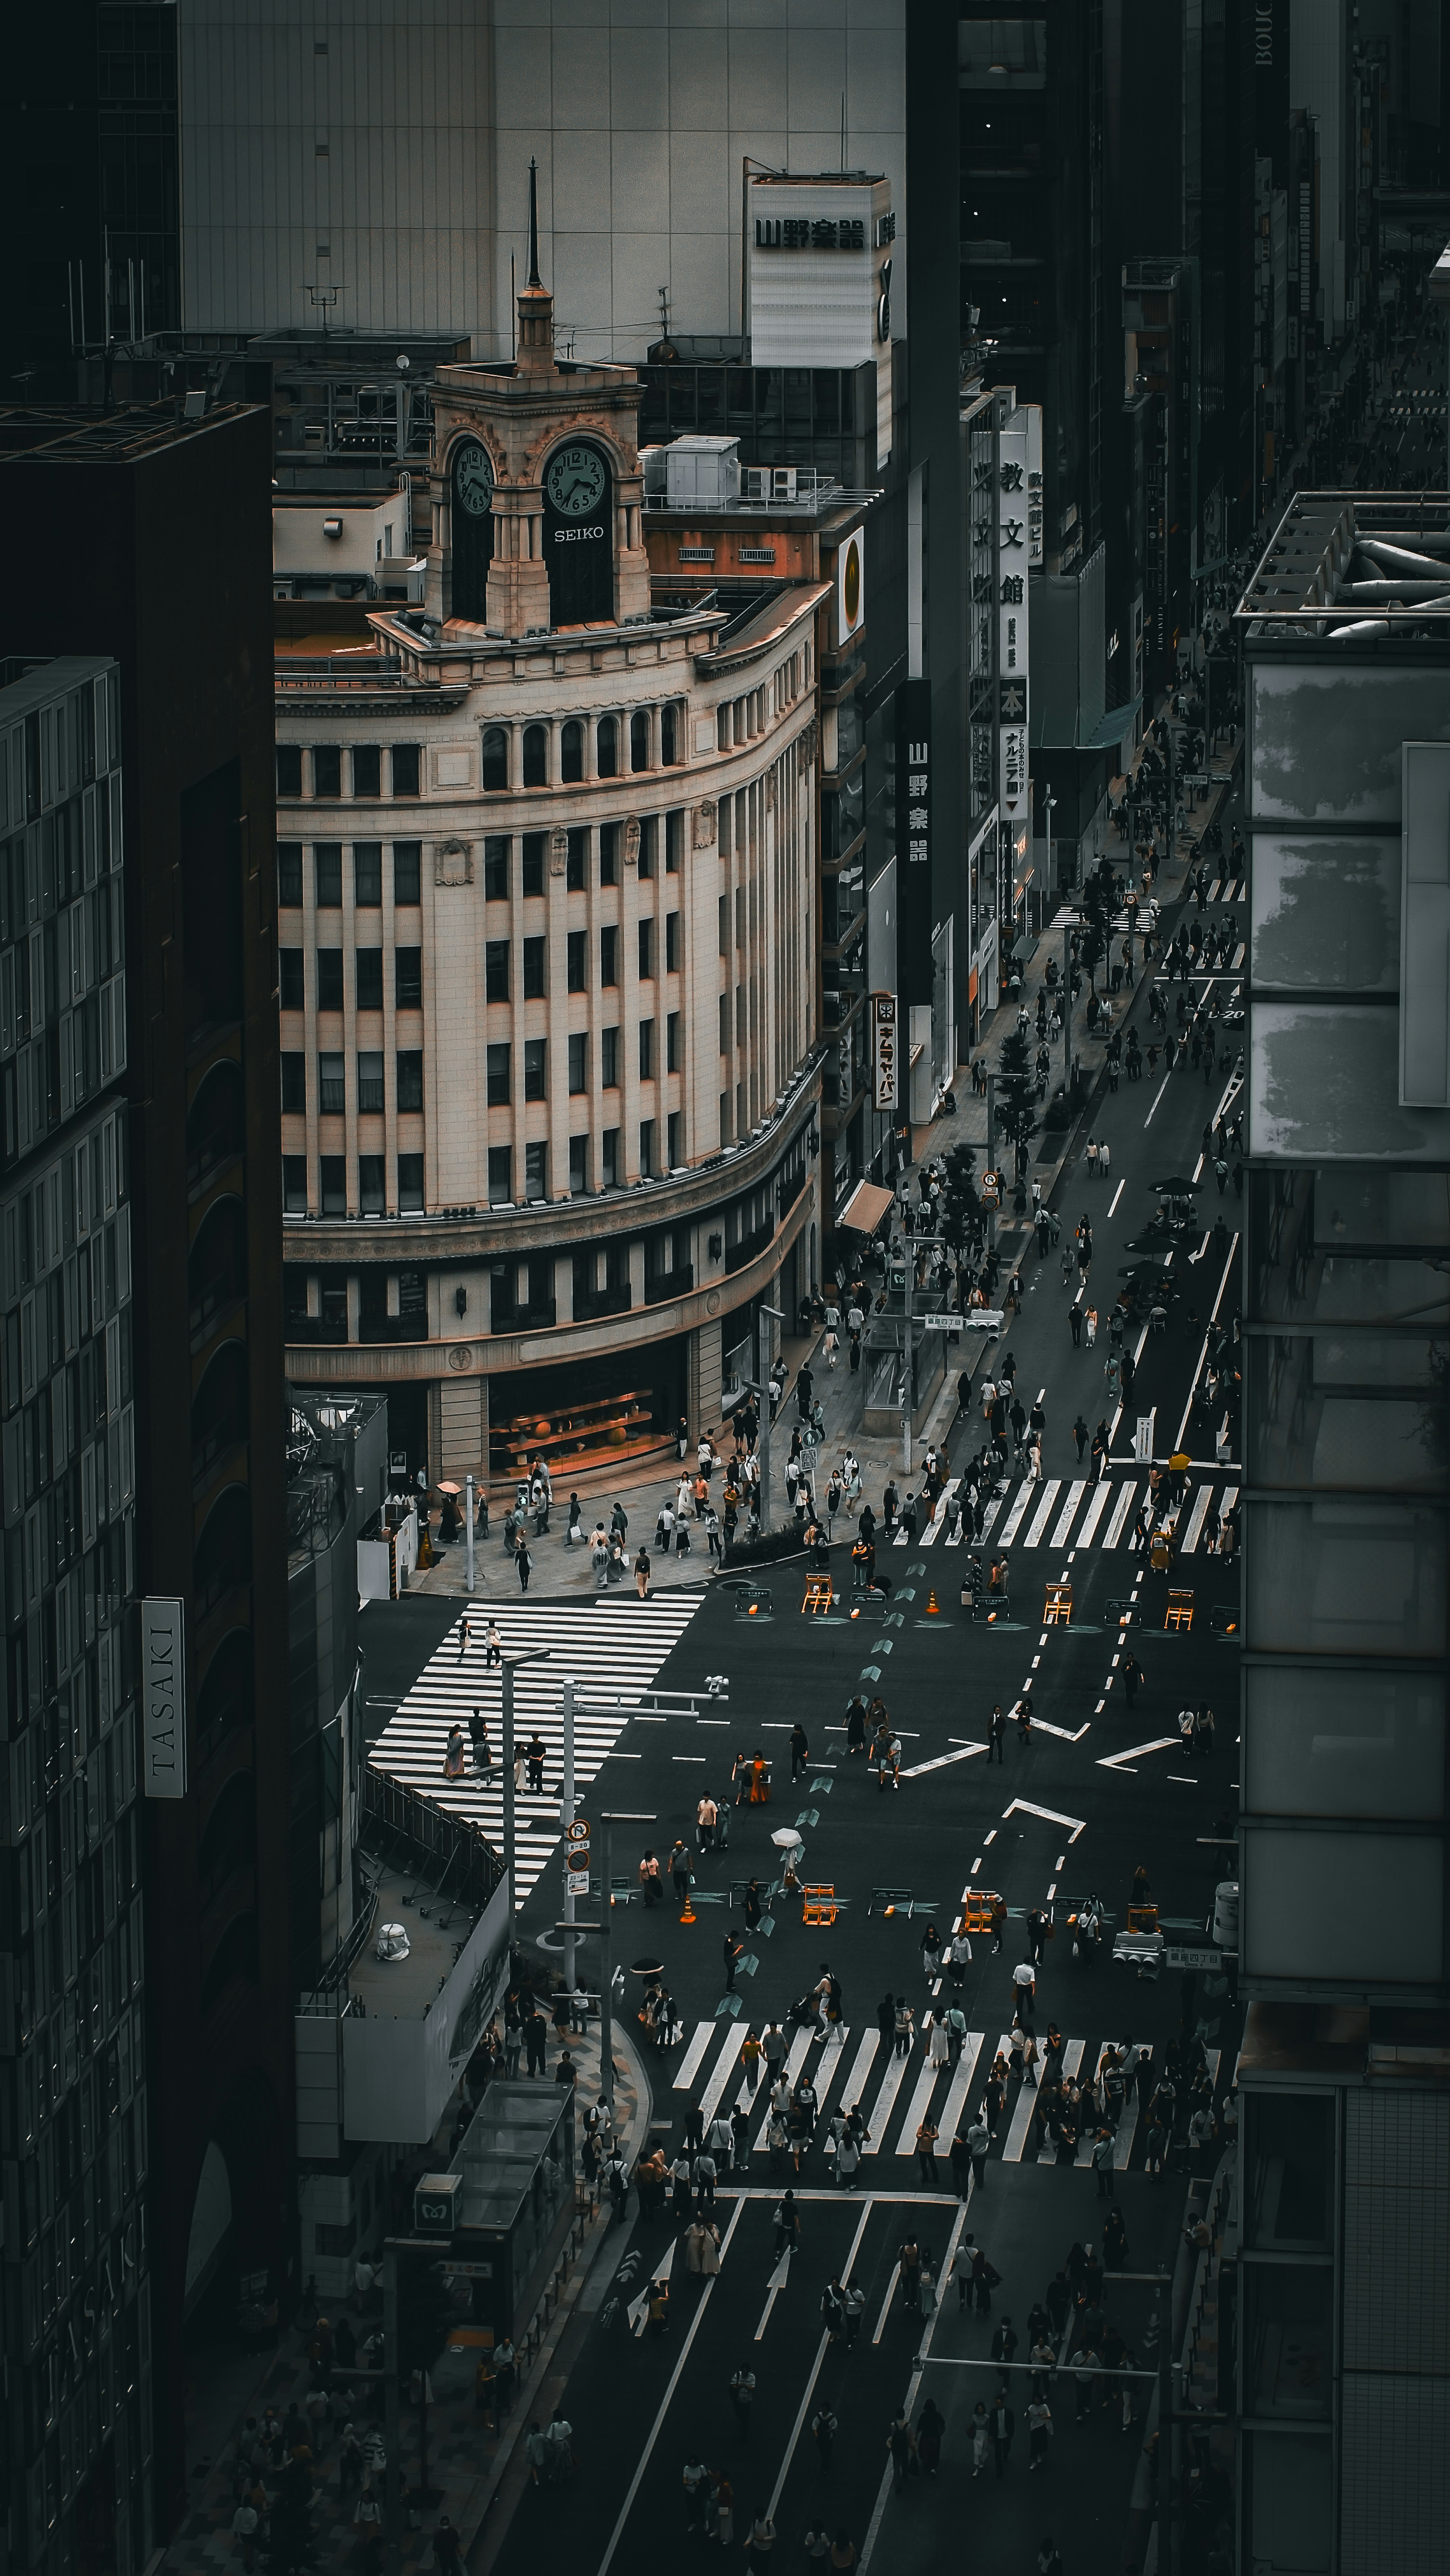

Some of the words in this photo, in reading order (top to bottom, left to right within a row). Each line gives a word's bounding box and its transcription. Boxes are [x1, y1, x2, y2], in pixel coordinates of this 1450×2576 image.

[756, 218, 864, 249] 山野楽器
[467, 453, 471, 464] 11
[472, 451, 478, 462] 12
[480, 455, 482, 466] 1
[563, 454, 569, 467] 11
[572, 452, 581, 463] 12
[585, 454, 587, 465] 1
[460, 462, 467, 472] 10
[484, 465, 488, 475] 2
[555, 466, 563, 476] 10
[590, 462, 597, 473] 2
[460, 473, 464, 483] 9
[552, 478, 559, 488] 9
[594, 474, 600, 485] 3
[468, 493, 472, 504] 7
[556, 489, 563, 500] 8
[473, 498, 478, 508] 6
[479, 496, 483, 506] 5
[572, 499, 580, 510] 6
[582, 495, 589, 506] 5
[1029, 471, 1043, 557] 教文館ビル
[555, 527, 604, 542] SEIKO
[1000, 461, 1024, 605] 教文館
[1001, 686, 1023, 716] 本
[909, 742, 928, 862] 山野楽器
[880, 1027, 895, 1103] キムラヤのパン
[150, 1626, 175, 1777] TASAKI
[43, 2202, 147, 2405] TASAKI
